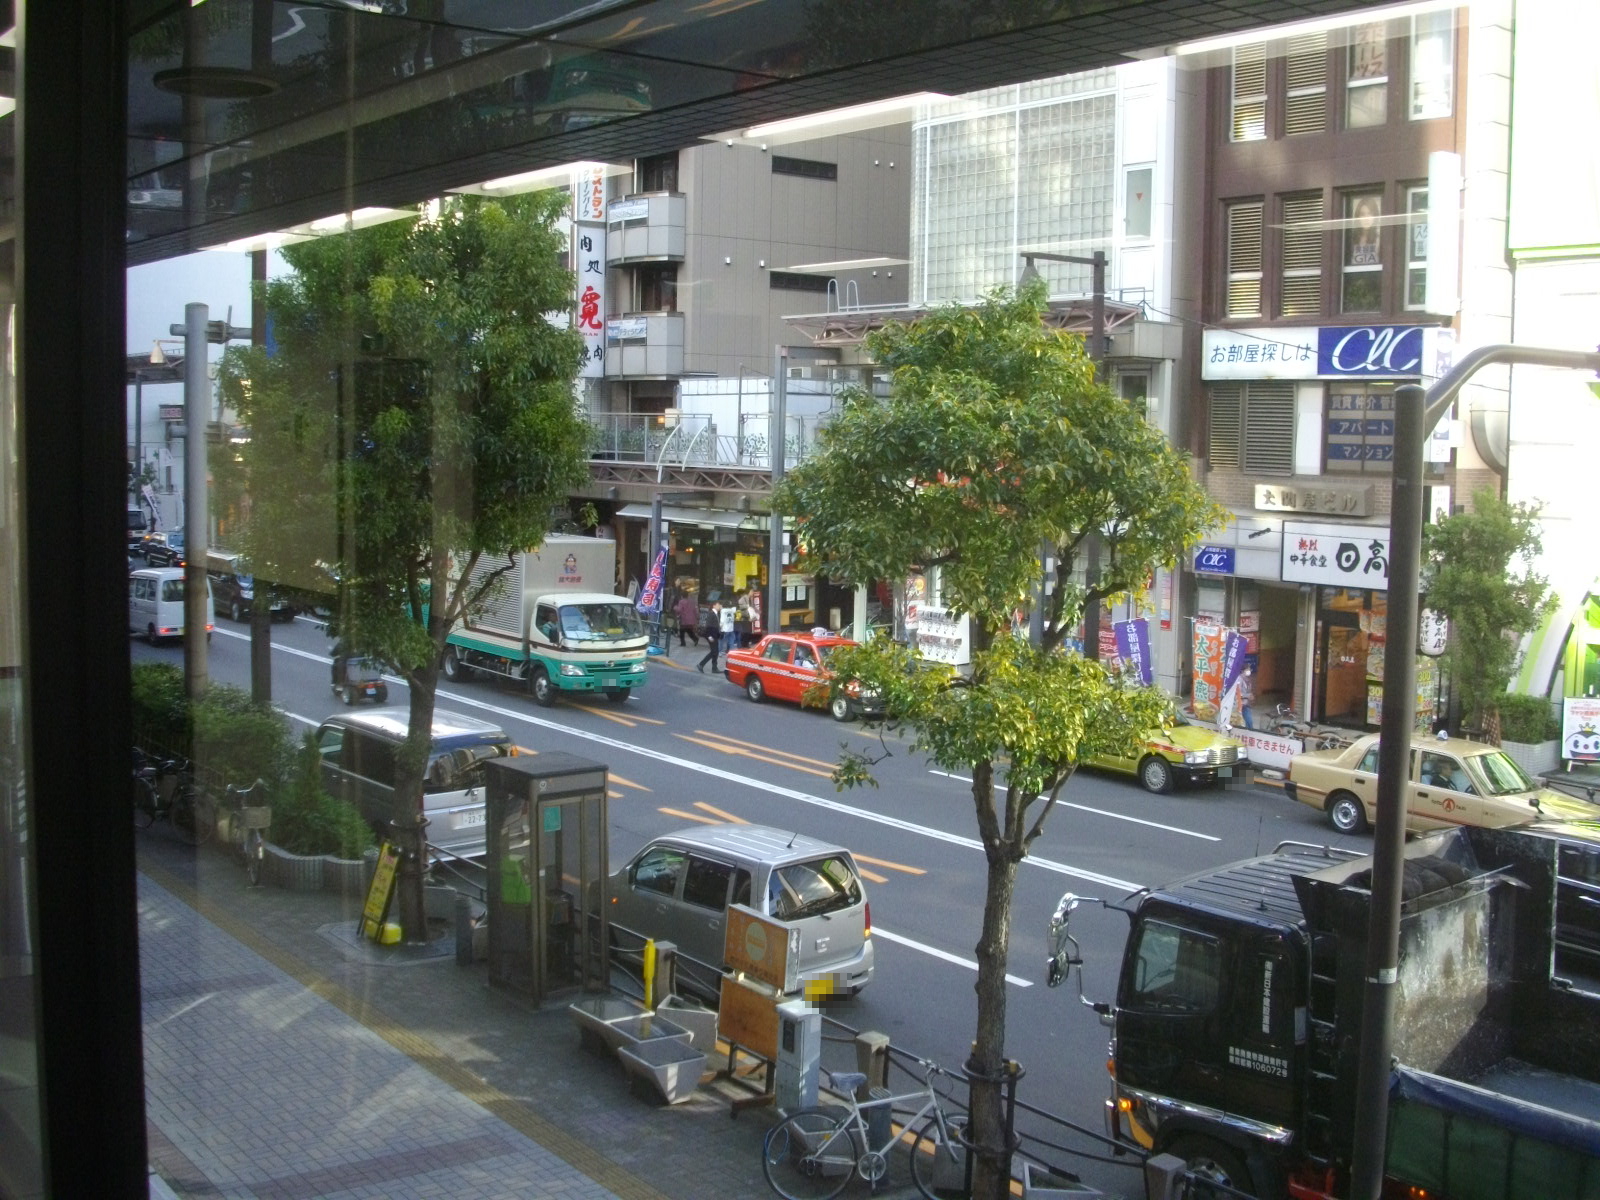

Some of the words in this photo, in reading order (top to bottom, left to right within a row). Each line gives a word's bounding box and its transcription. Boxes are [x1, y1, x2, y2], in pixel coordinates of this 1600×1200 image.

[1354, 253, 1376, 263] GIA
[1210, 342, 1312, 364] お部屋探しは
[1339, 420, 1389, 435] アパート
[1343, 445, 1393, 460] マンション
[1289, 552, 1327, 567] 中華食堂
